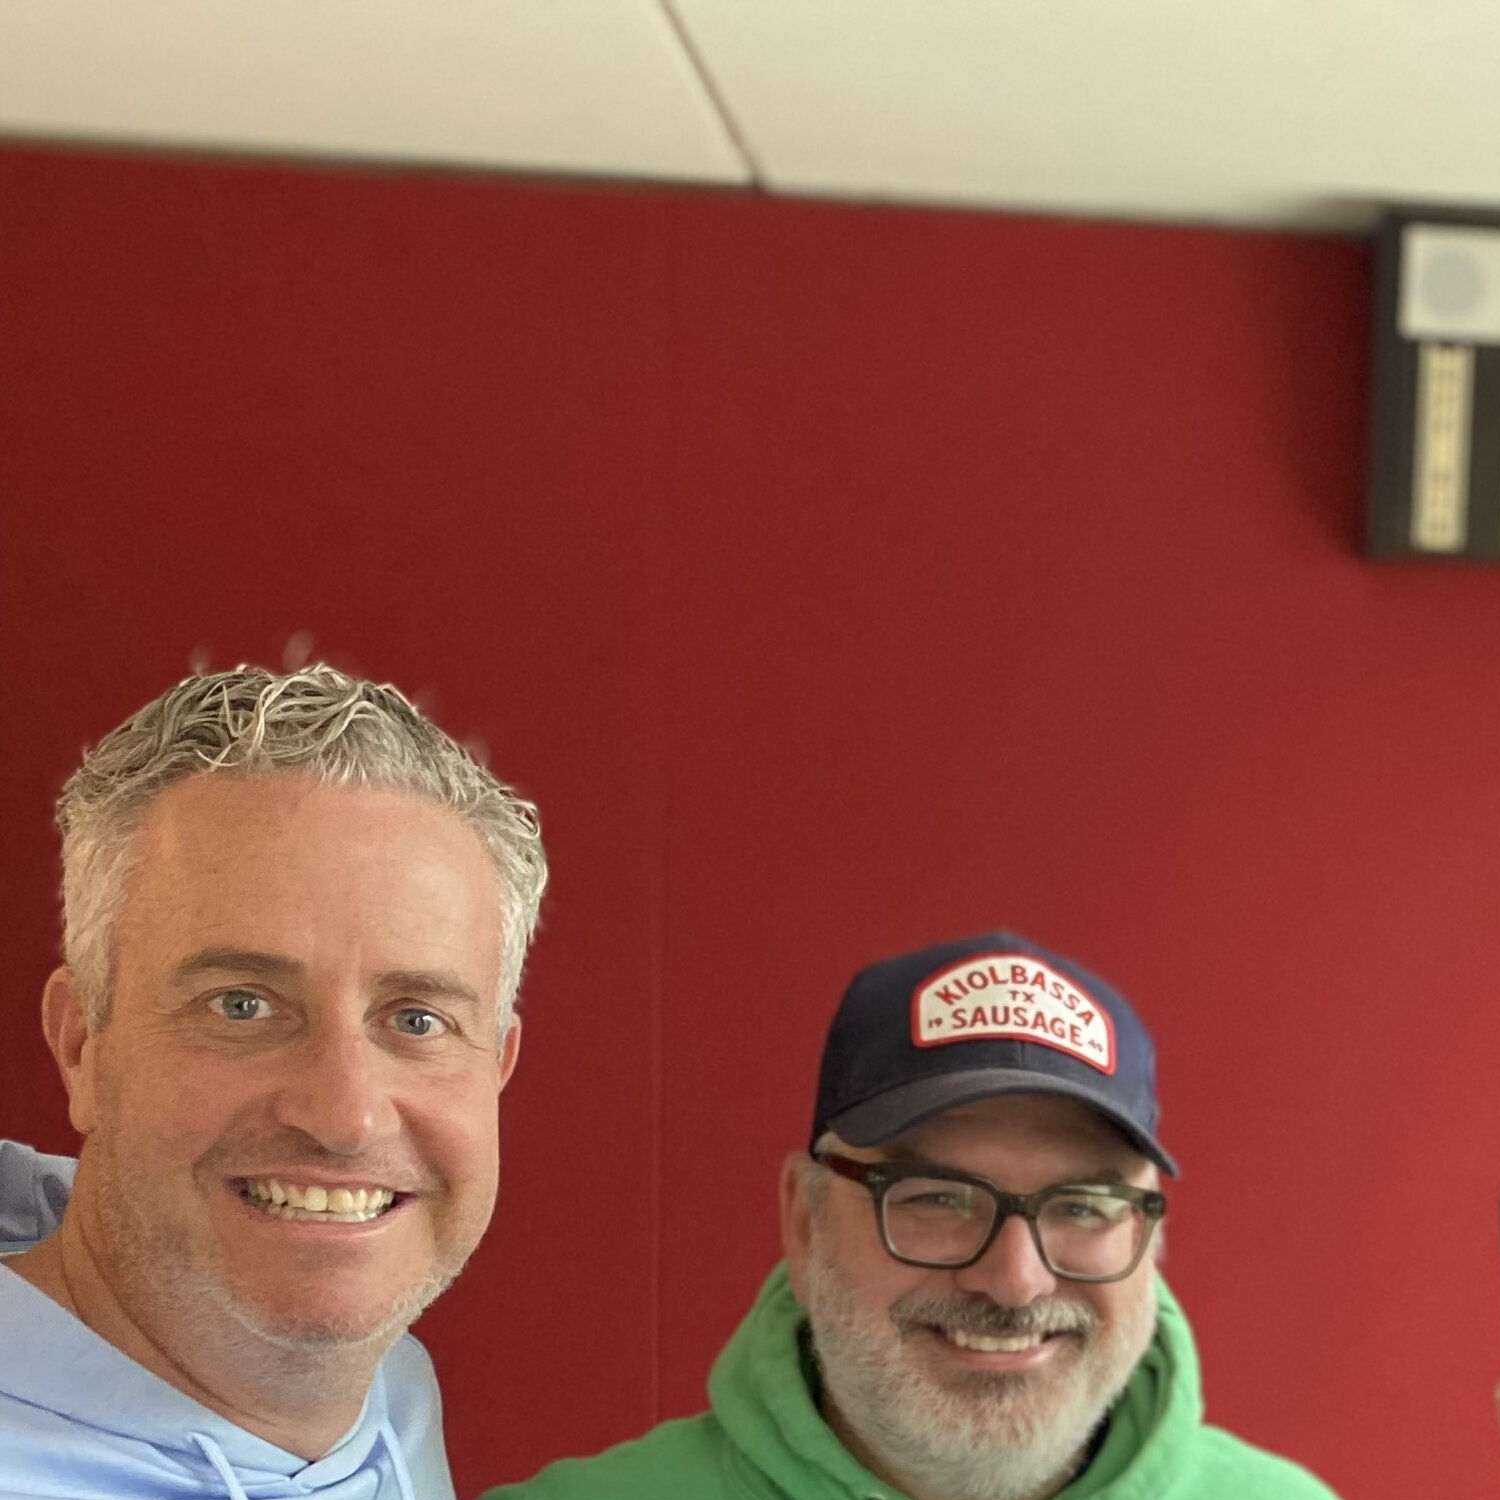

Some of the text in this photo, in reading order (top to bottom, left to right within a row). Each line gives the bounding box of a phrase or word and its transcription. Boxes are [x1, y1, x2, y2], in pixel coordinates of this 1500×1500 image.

[934, 964, 1095, 1027] KIOLBASSA
[1008, 990, 1036, 1005] TX
[952, 1006, 1083, 1047] SAUSAGE
